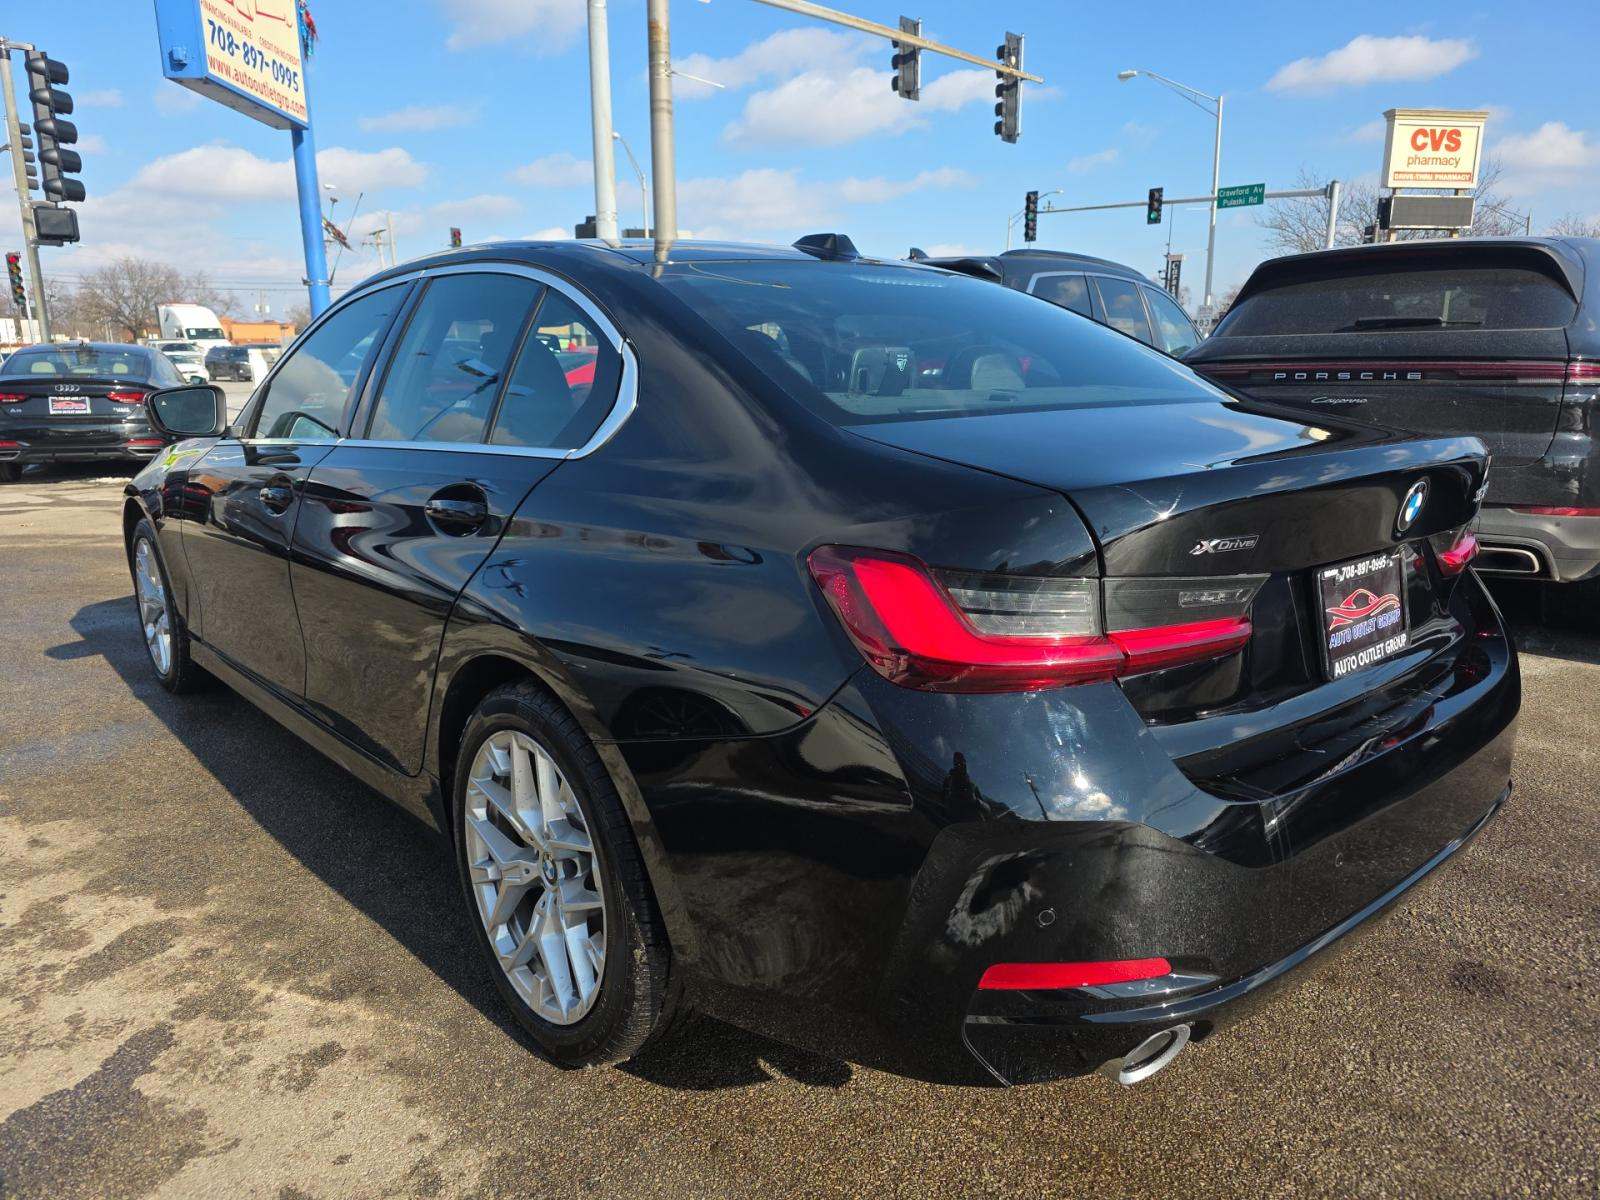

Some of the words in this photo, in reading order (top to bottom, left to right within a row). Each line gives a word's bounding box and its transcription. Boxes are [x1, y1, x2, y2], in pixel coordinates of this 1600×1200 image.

[207, 18, 299, 92] 708-897-0995
[207, 54, 305, 116] www.autooutletgrp.com
[1410, 128, 1462, 152] CVS
[1406, 154, 1461, 168] pharmacy
[1434, 173, 1471, 181] PHARMACY
[1218, 188, 1250, 198] Crawford
[1248, 196, 1258, 204] Rd
[1274, 372, 1422, 380] PORSCHE
[1329, 628, 1353, 648] AUTO
[1352, 617, 1377, 639] OUTLET
[1377, 608, 1401, 629] GROUP
[1334, 653, 1357, 677] AUTO
[1358, 642, 1386, 666] OUTLET
[1385, 633, 1407, 654] GROUP
